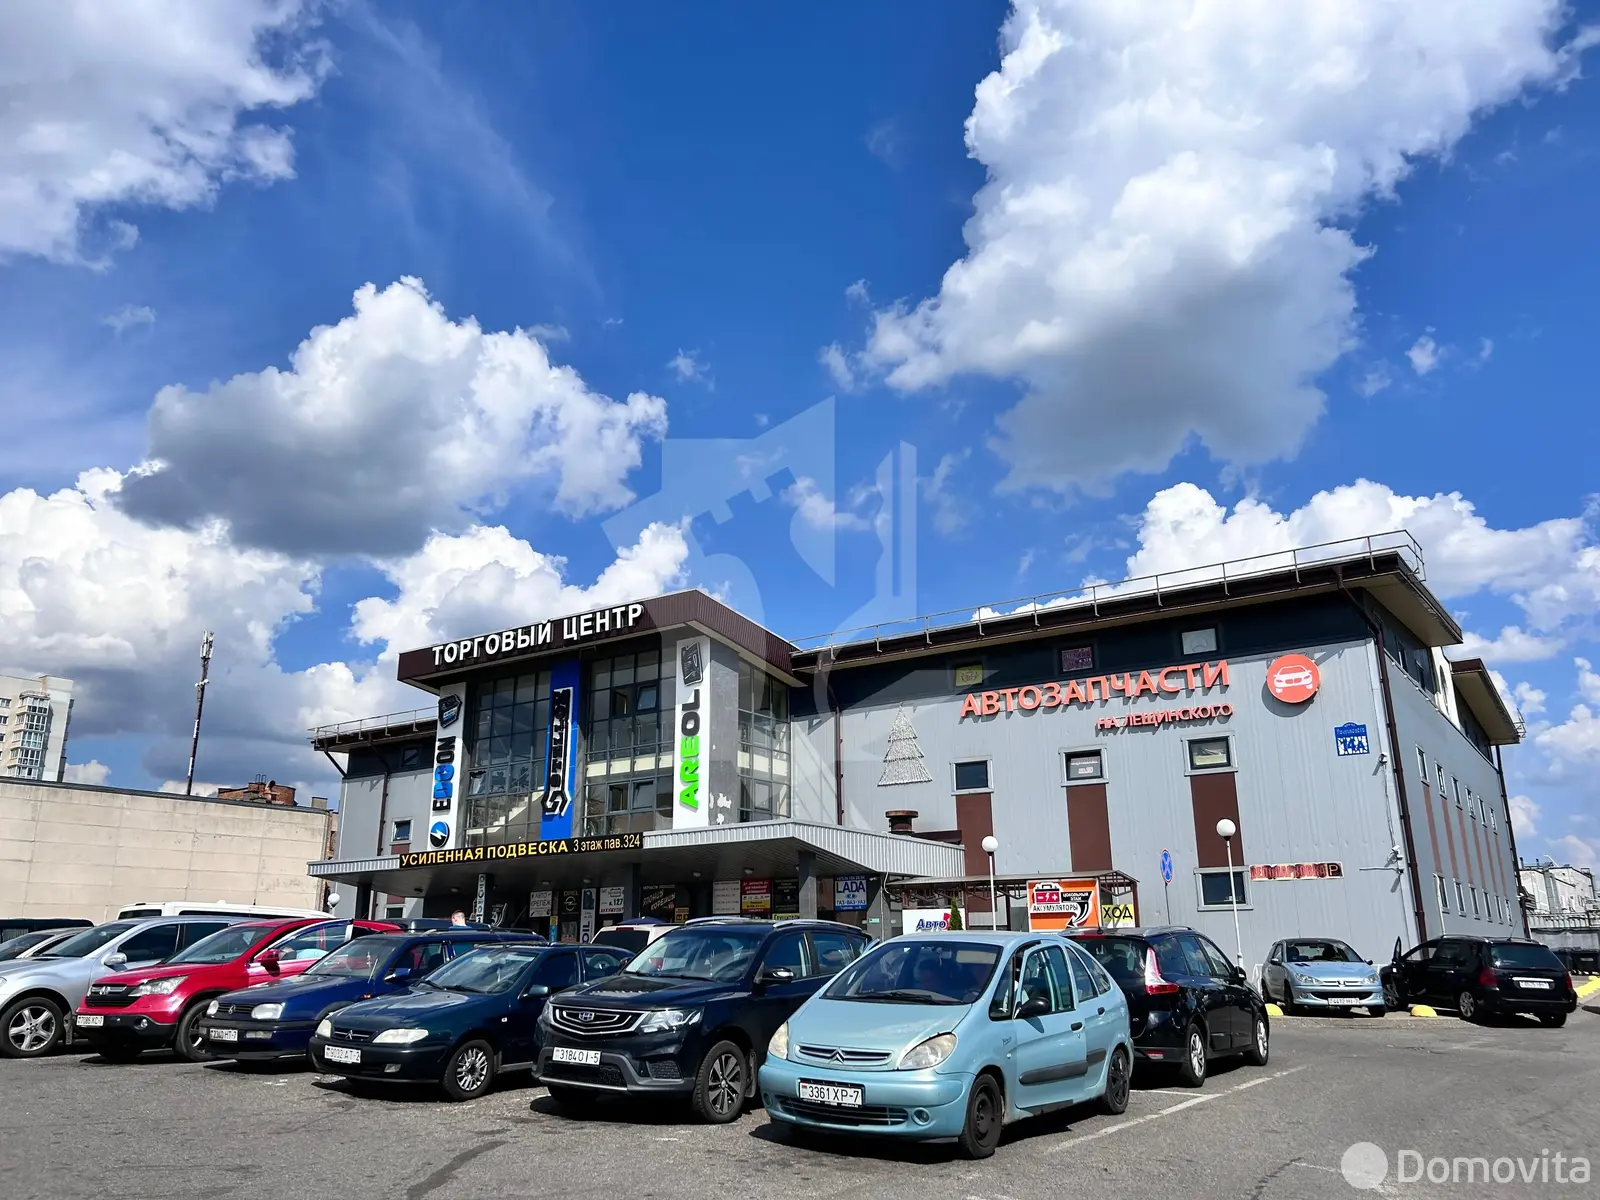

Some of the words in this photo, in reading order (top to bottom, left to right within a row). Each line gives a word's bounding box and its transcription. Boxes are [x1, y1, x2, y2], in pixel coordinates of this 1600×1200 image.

[432, 619, 551, 666] ТОРГОВЫЙ
[563, 603, 643, 641] ЦЕНТР
[960, 660, 1230, 717] АВТОЗАПЧАСТИ
[1097, 716, 1118, 730] НА
[1119, 704, 1233, 728] ЛЕЩИНСКОГО
[679, 689, 701, 811] AREOL
[402, 847, 484, 866] УСИЛЕННАЯ
[487, 839, 568, 860] ПОДВЕСКА
[573, 839, 580, 852] 3
[580, 839, 603, 851] этаж
[604, 834, 642, 851] пав.324
[836, 880, 866, 893] LADA
[916, 918, 946, 929] Авто
[809, 1085, 830, 1100] 3361
[833, 1087, 860, 1103] XP-7
